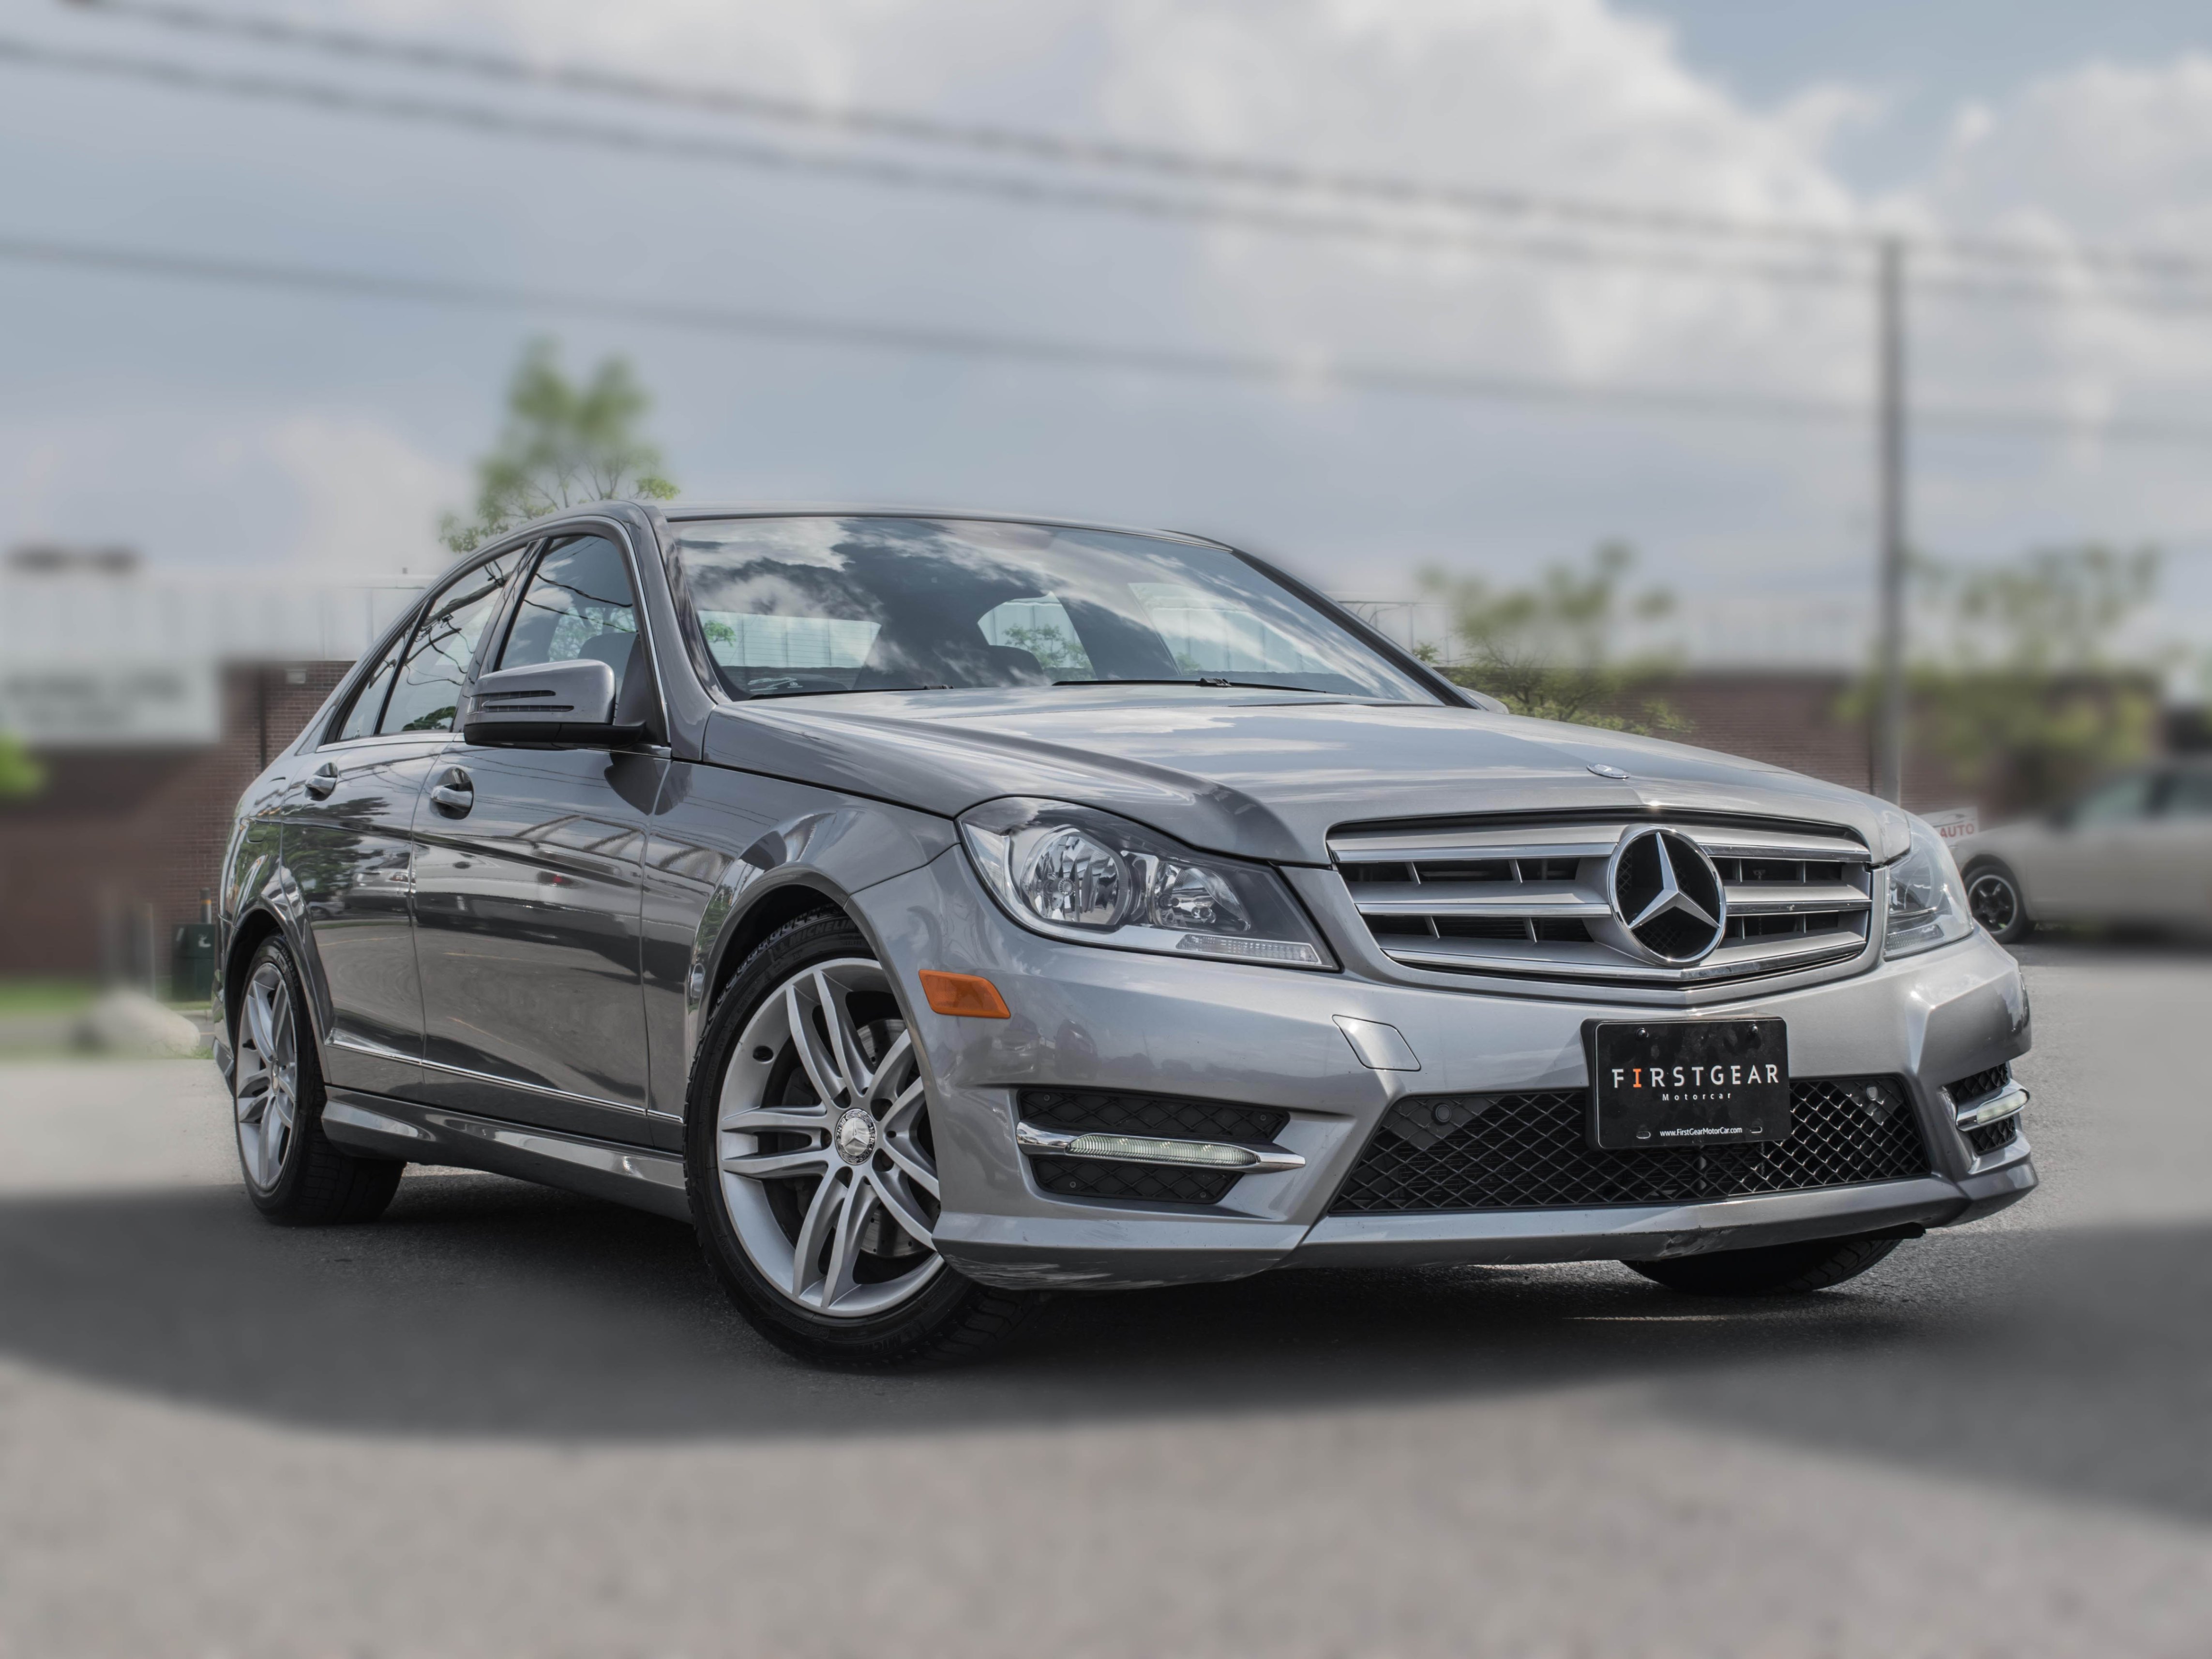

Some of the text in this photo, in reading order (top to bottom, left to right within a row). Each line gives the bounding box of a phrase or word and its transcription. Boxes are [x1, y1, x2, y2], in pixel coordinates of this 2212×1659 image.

[1940, 824, 1974, 838] AUTO
[1611, 1064, 1779, 1088] FIRSTGEAR
[1662, 1093, 1731, 1101] Motorcar
[836, 1117, 846, 1139] BENZ
[1660, 1127, 1742, 1136] www.FirstGearMotorCar.com
